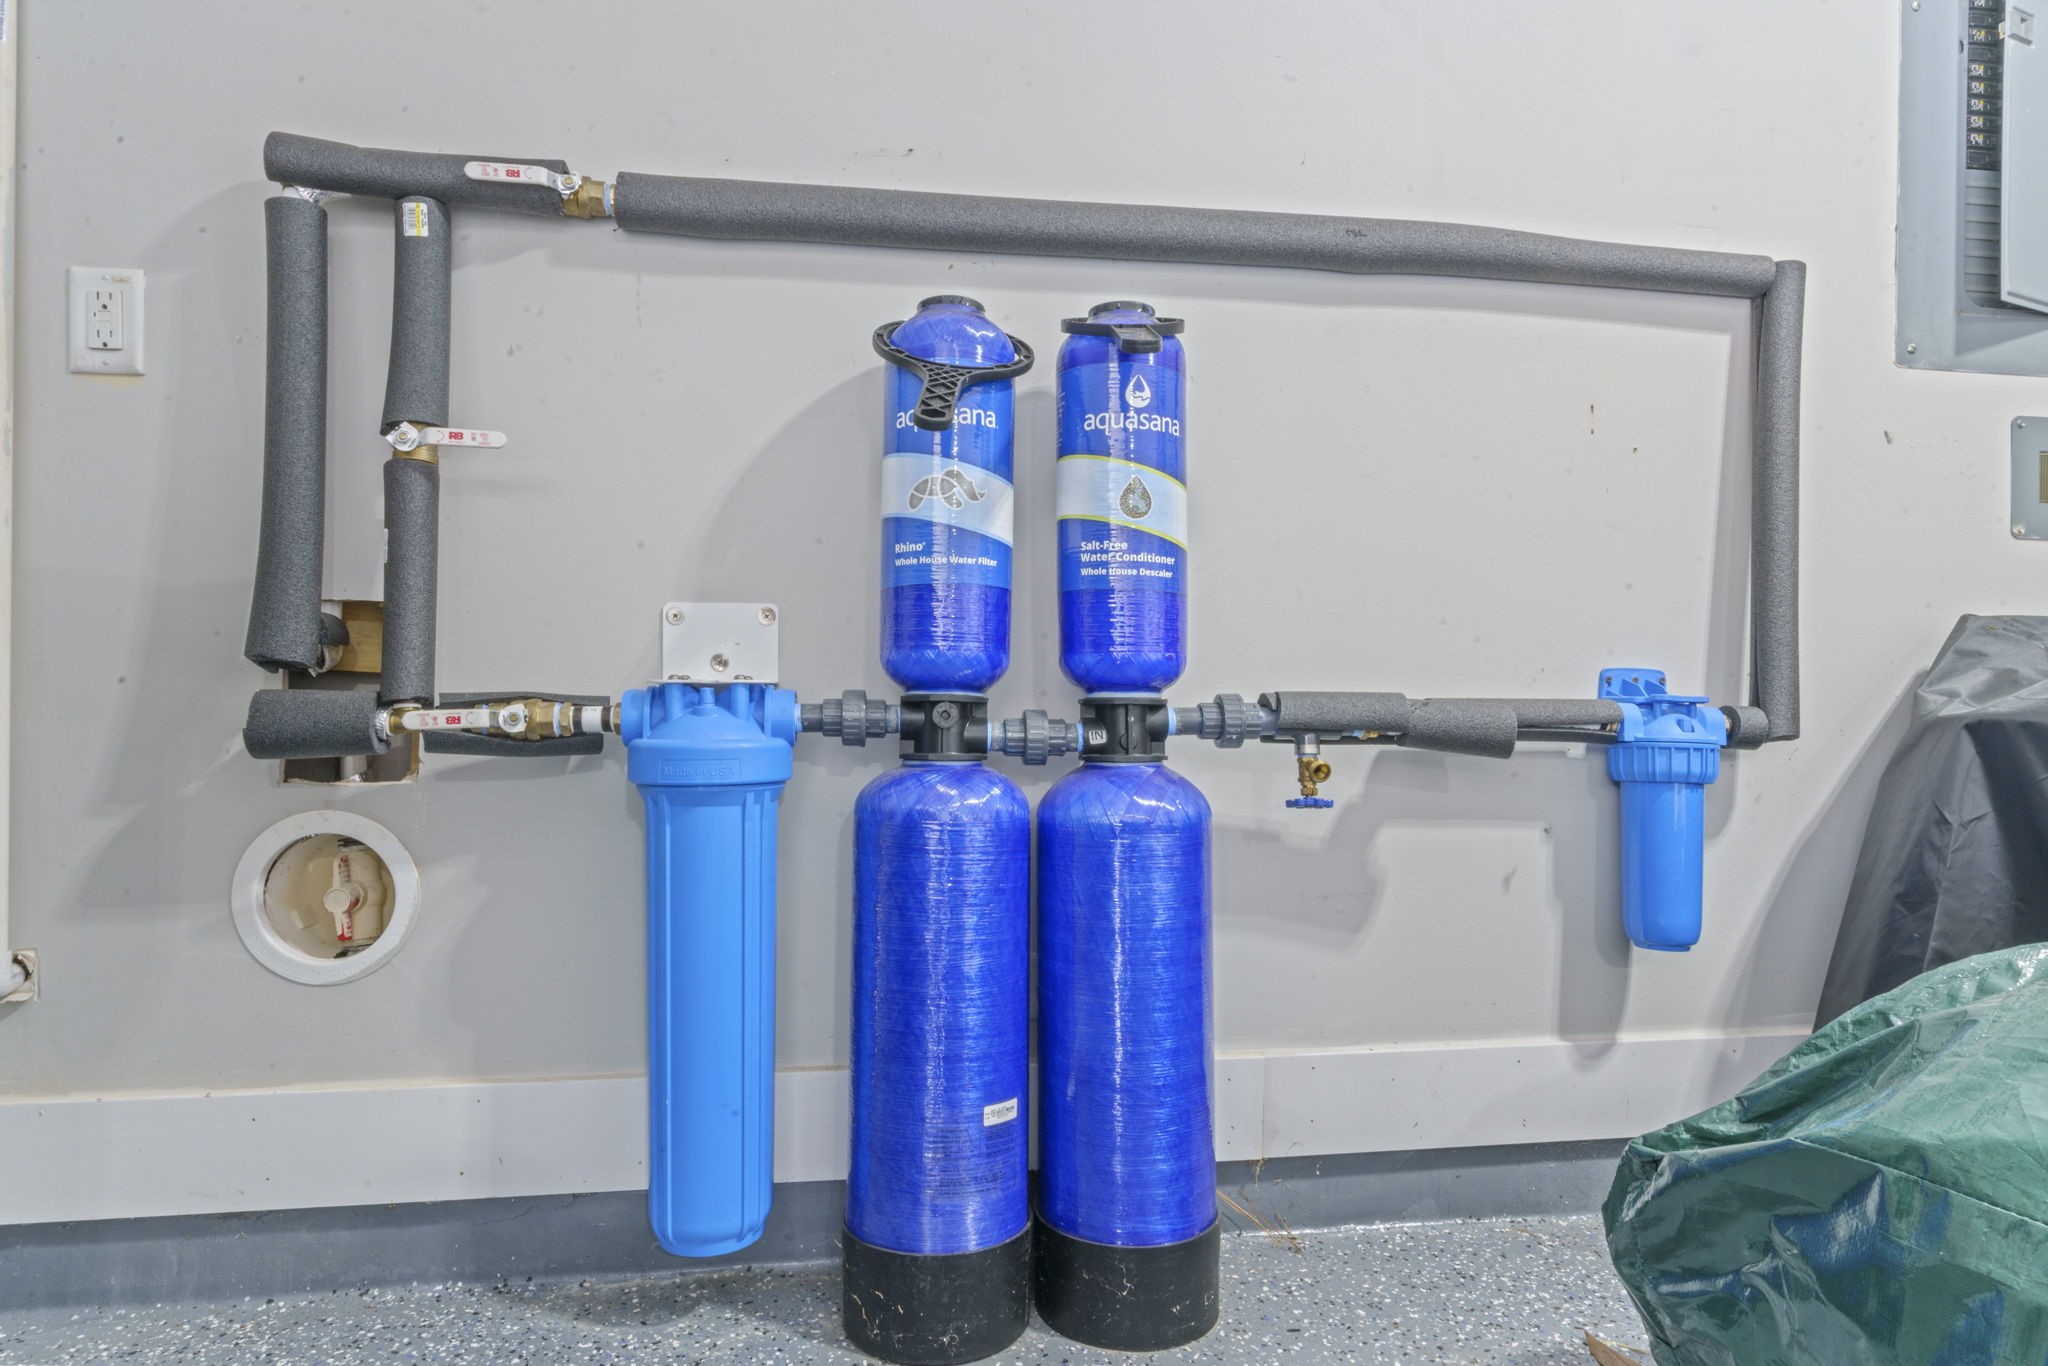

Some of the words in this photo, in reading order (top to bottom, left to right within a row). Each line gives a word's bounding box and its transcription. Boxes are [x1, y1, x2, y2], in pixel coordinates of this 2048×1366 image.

[505, 168, 521, 179] RB
[896, 407, 996, 432] aqana
[1083, 411, 1180, 436] aquasana
[448, 431, 464, 440] RB
[1081, 540, 1128, 551] Salt-Free
[895, 557, 918, 566] Whole
[919, 555, 948, 565] House
[949, 556, 977, 565] Water
[978, 556, 998, 567] Filter
[1081, 553, 1112, 562] Water
[1115, 552, 1176, 565] Conditioner
[1081, 567, 1107, 576] Whole
[1109, 567, 1138, 576] House
[1139, 568, 1173, 578] Descaler
[445, 715, 461, 725] RB
[1091, 730, 1104, 741] IN
[663, 766, 693, 776] Made
[695, 767, 706, 776] in
[709, 766, 736, 776] USA
